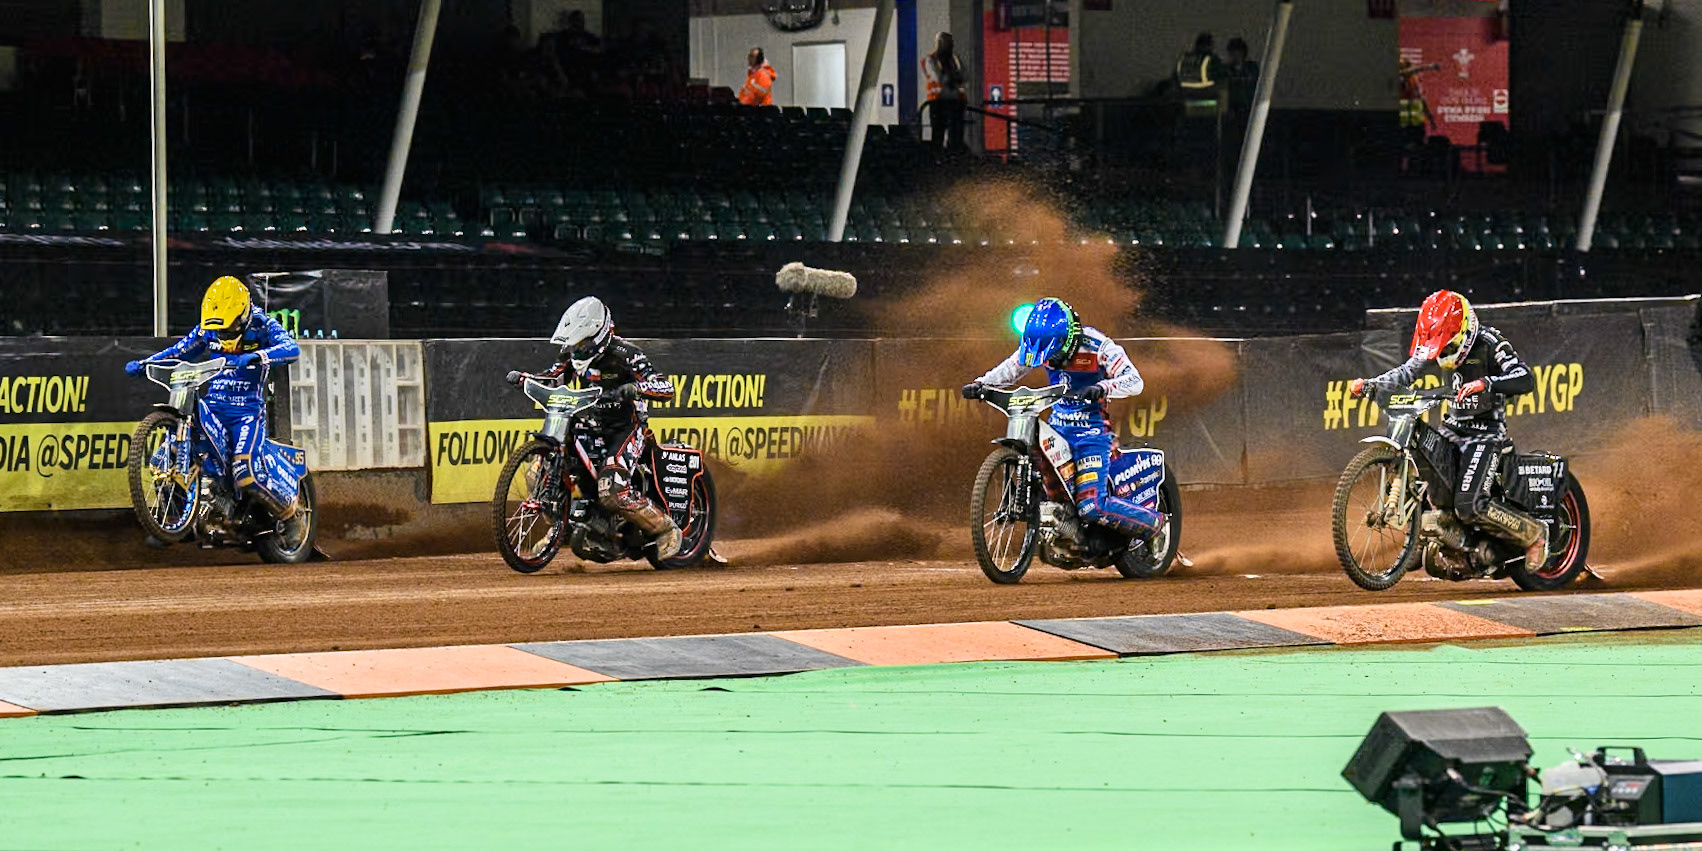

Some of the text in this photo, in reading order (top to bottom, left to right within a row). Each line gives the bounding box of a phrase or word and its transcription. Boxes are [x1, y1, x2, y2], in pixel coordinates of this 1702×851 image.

[0, 376, 89, 414] ACTION!
[687, 374, 766, 409] ACTION!
[37, 433, 158, 477] @SPEED
[293, 451, 305, 466] 95
[437, 430, 520, 466] FOLLOW
[1151, 454, 1162, 466] 99
[1461, 451, 1483, 492] BETARD
[1525, 461, 1565, 479] BETARD 71
